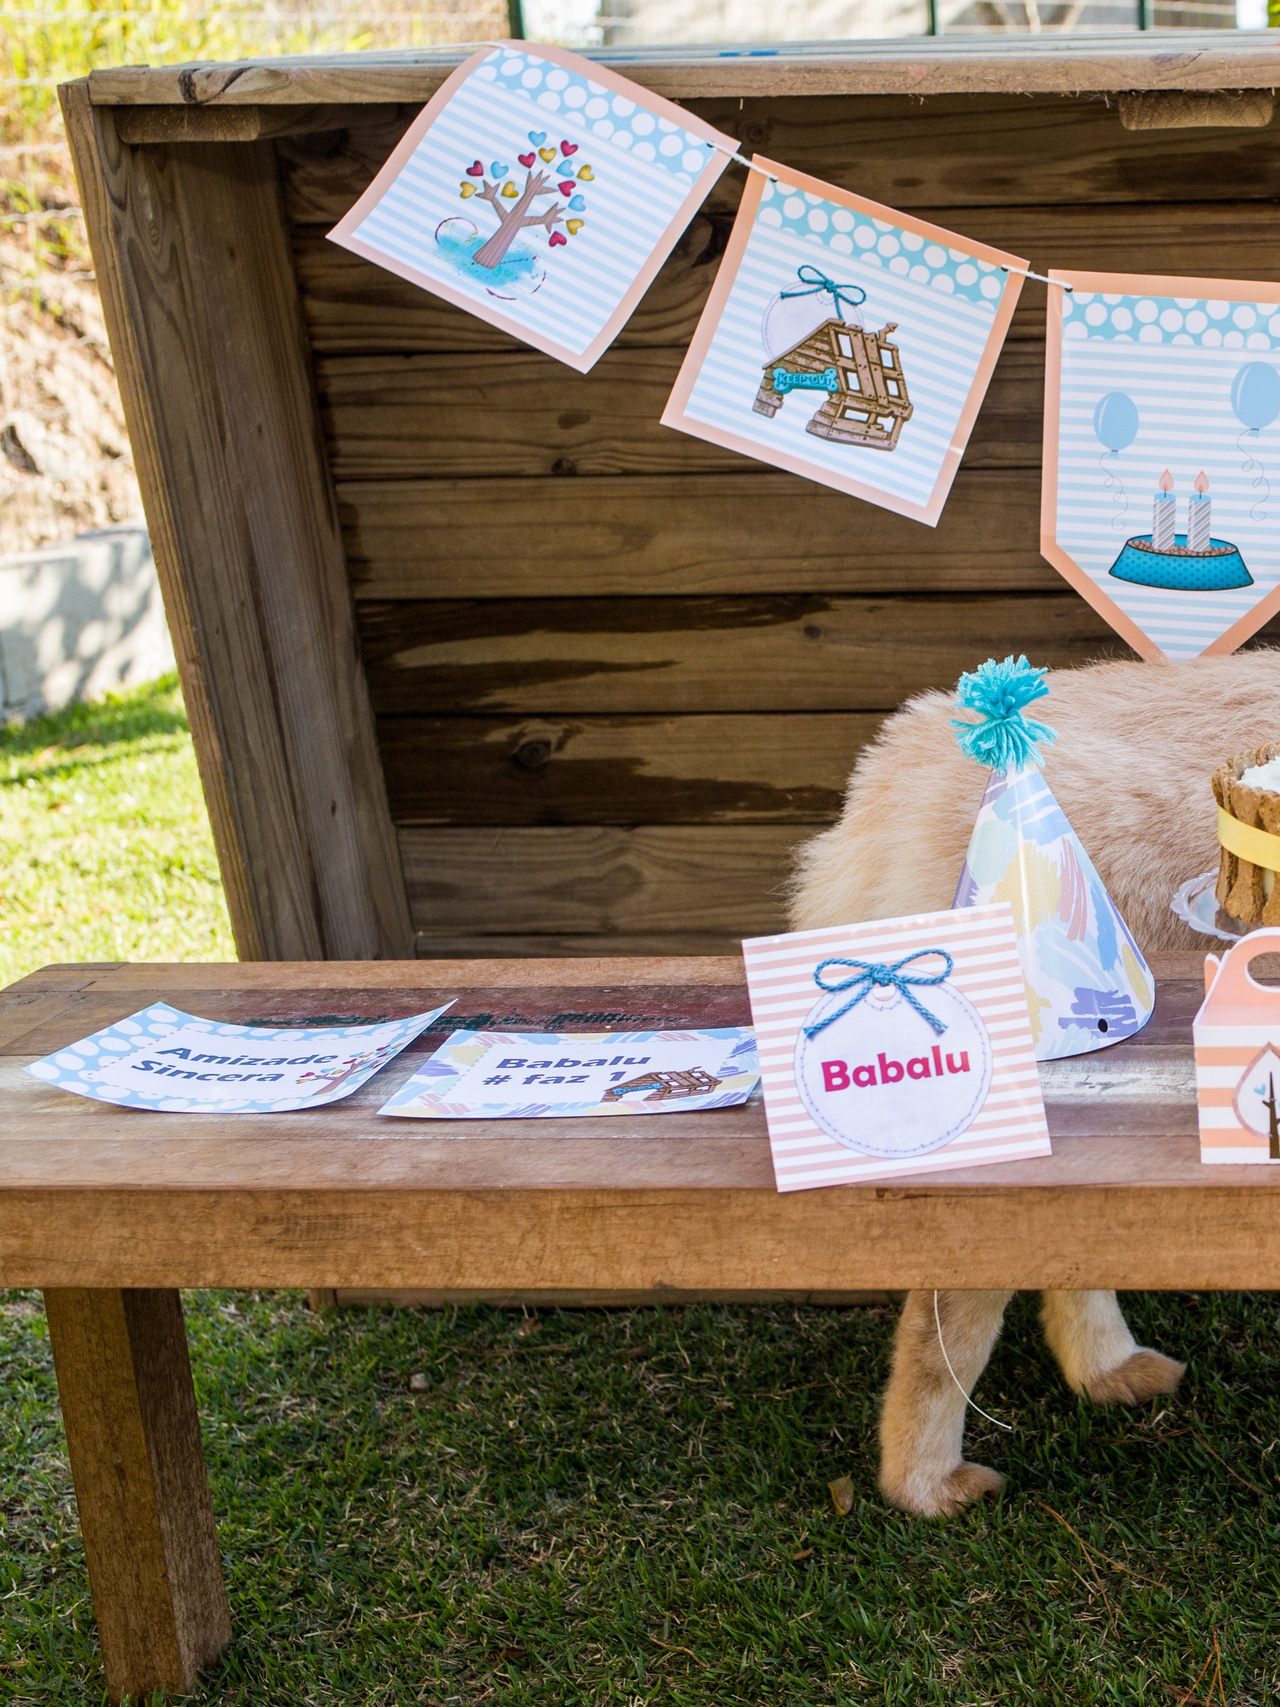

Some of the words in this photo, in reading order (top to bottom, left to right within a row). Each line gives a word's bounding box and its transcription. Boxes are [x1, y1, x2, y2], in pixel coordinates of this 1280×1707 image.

[777, 372, 807, 387] KEEP
[811, 373, 832, 387] OUT
[154, 1047, 339, 1066] Amizade
[495, 1055, 652, 1069] Babalu
[131, 1060, 285, 1083] Sincera
[821, 1045, 971, 1092] Babalu
[521, 1073, 590, 1085] faz
[609, 1071, 627, 1082] 1
